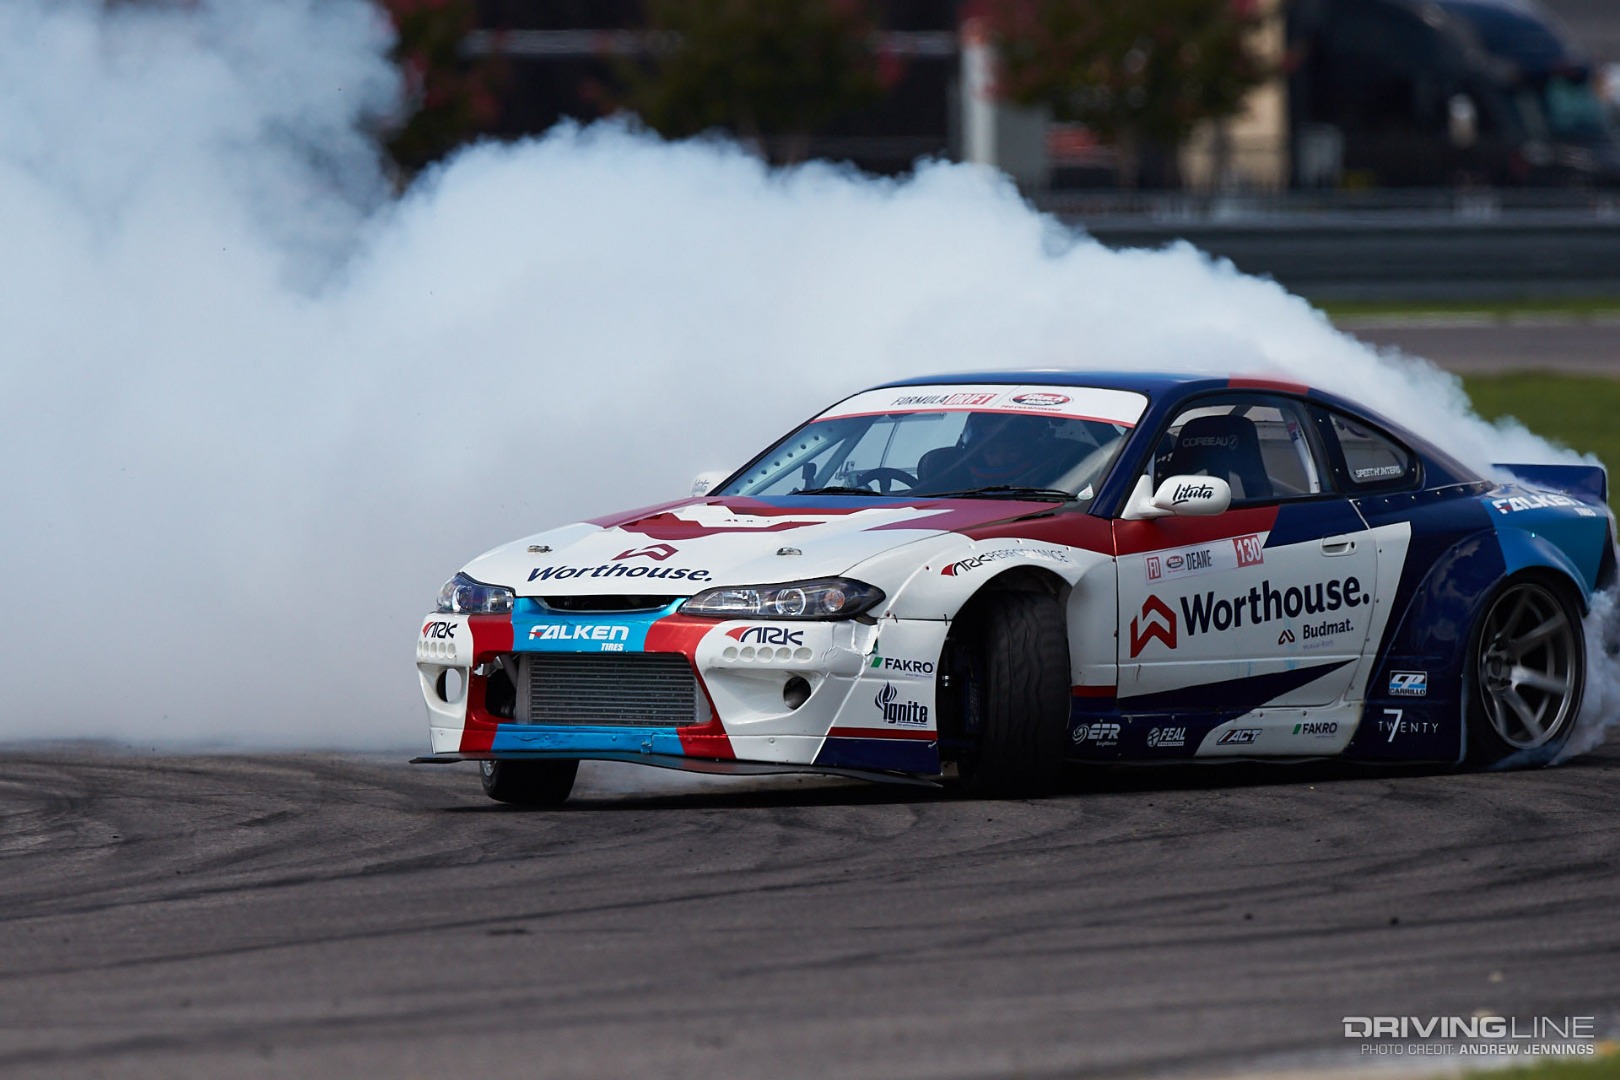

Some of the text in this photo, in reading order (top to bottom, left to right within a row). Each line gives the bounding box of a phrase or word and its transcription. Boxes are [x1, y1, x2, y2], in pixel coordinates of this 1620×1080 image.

[890, 395, 949, 405] FORMULA
[1182, 435, 1228, 448] CORBEAU
[1172, 484, 1214, 505] Lituta
[1236, 537, 1261, 563] 130
[1148, 558, 1160, 578] FD
[1185, 549, 1212, 571] DEANE
[527, 563, 713, 582] Worthouse.
[1180, 576, 1370, 636] Worthouse.
[425, 621, 458, 639] ARK
[528, 624, 630, 641] FALKEN
[739, 626, 804, 646] ARK
[1303, 618, 1354, 640] Budmat.
[601, 642, 623, 652] TIRES
[884, 657, 934, 674] FAKRO
[883, 700, 928, 724] ignite
[1087, 723, 1121, 740] EFR
[1159, 727, 1186, 741] FEAL
[1226, 729, 1262, 742] ACT
[1302, 722, 1338, 735] FAKRO
